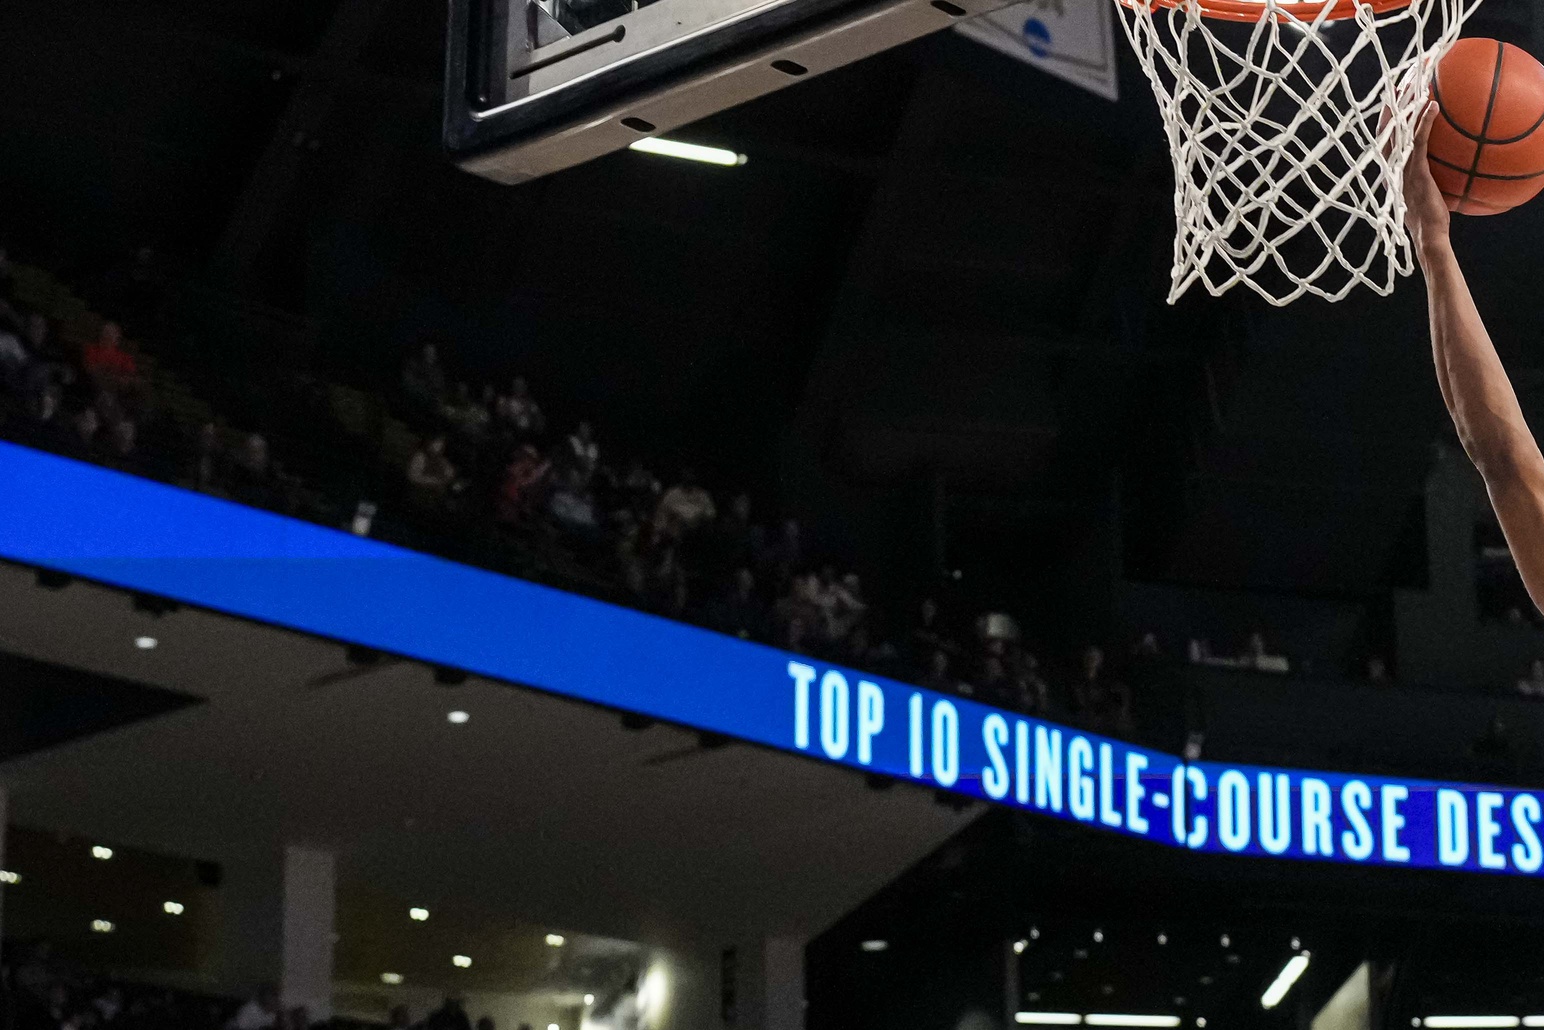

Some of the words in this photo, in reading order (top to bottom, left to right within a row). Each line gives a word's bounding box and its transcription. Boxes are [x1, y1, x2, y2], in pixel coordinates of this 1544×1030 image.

[787, 660, 885, 766] TOP
[909, 691, 960, 787] 10
[981, 713, 1411, 862] SINGLE-COURSE
